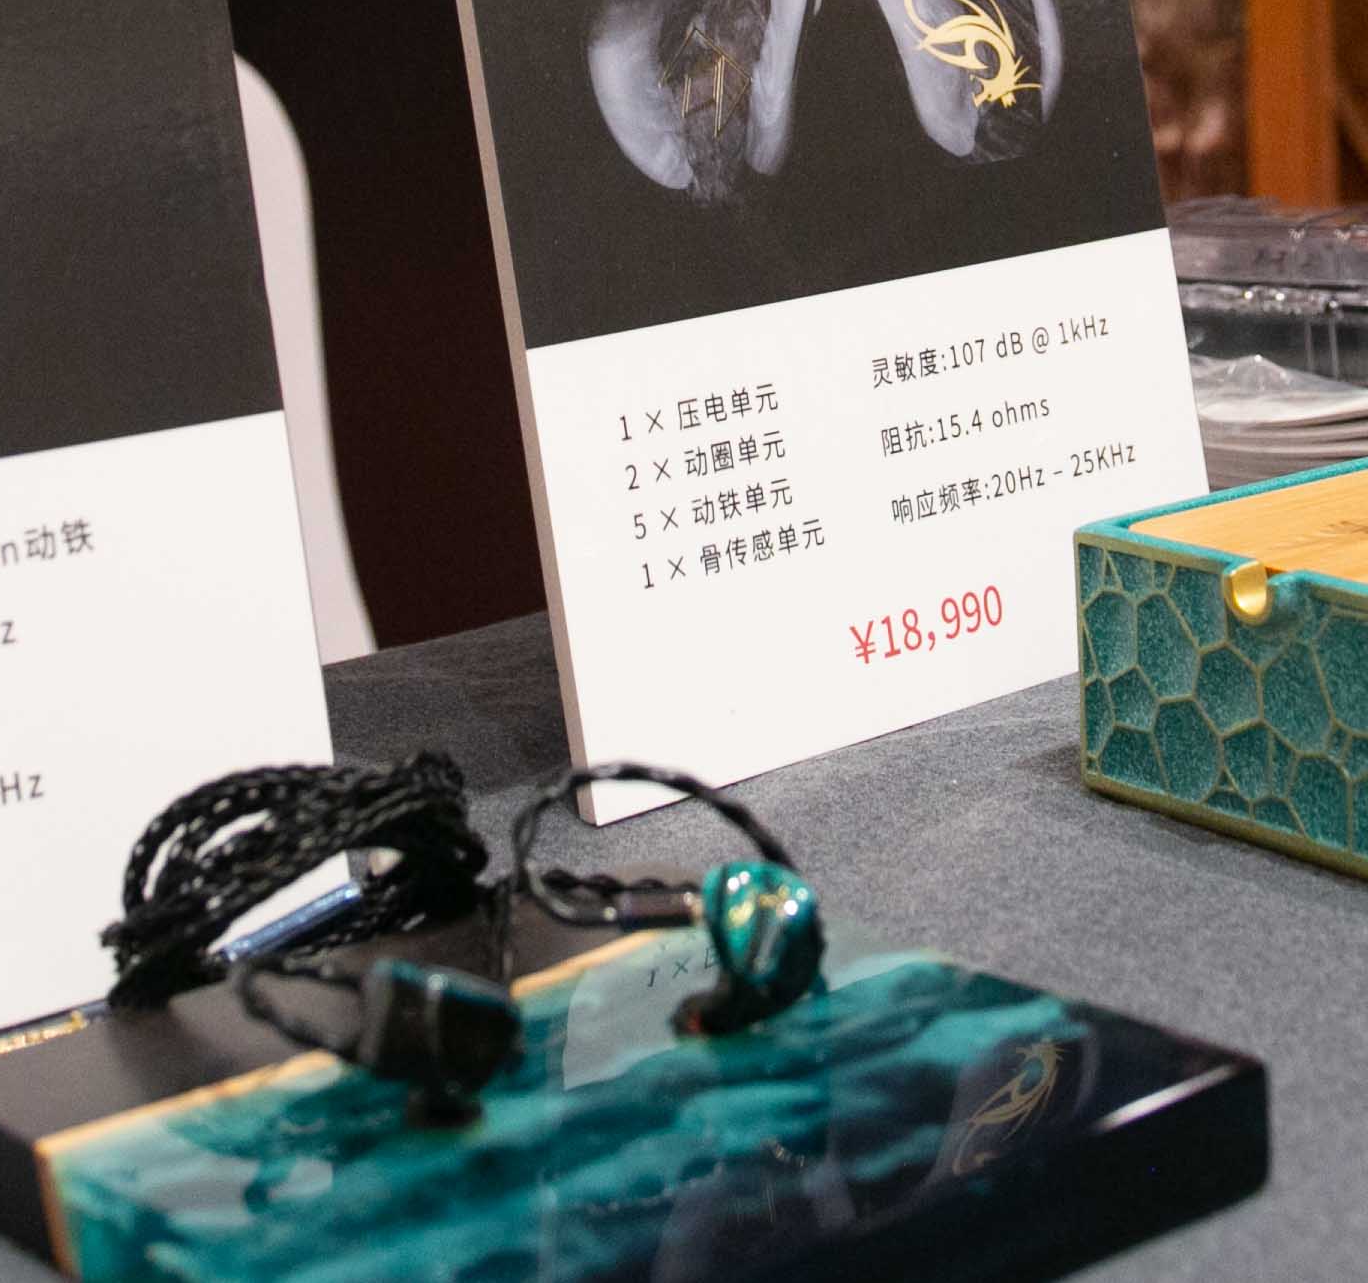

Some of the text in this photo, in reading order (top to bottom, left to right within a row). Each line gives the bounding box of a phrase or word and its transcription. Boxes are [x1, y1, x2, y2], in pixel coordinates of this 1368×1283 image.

[871, 314, 1110, 389] 灵敏度:107 dB @ 1kHz
[619, 414, 632, 441] 1
[676, 382, 780, 432] 压电单元
[880, 397, 1050, 457] 阻抗:15.4 ohms
[625, 465, 639, 491] 2
[684, 430, 787, 480] 动圈单元
[890, 466, 1046, 525] 响应频率:20Hz
[1071, 442, 1137, 478] 25KHz
[633, 513, 647, 540] 5
[691, 477, 794, 528] 动铁单元
[641, 561, 655, 589] 1
[699, 518, 827, 578] 骨传感单元
